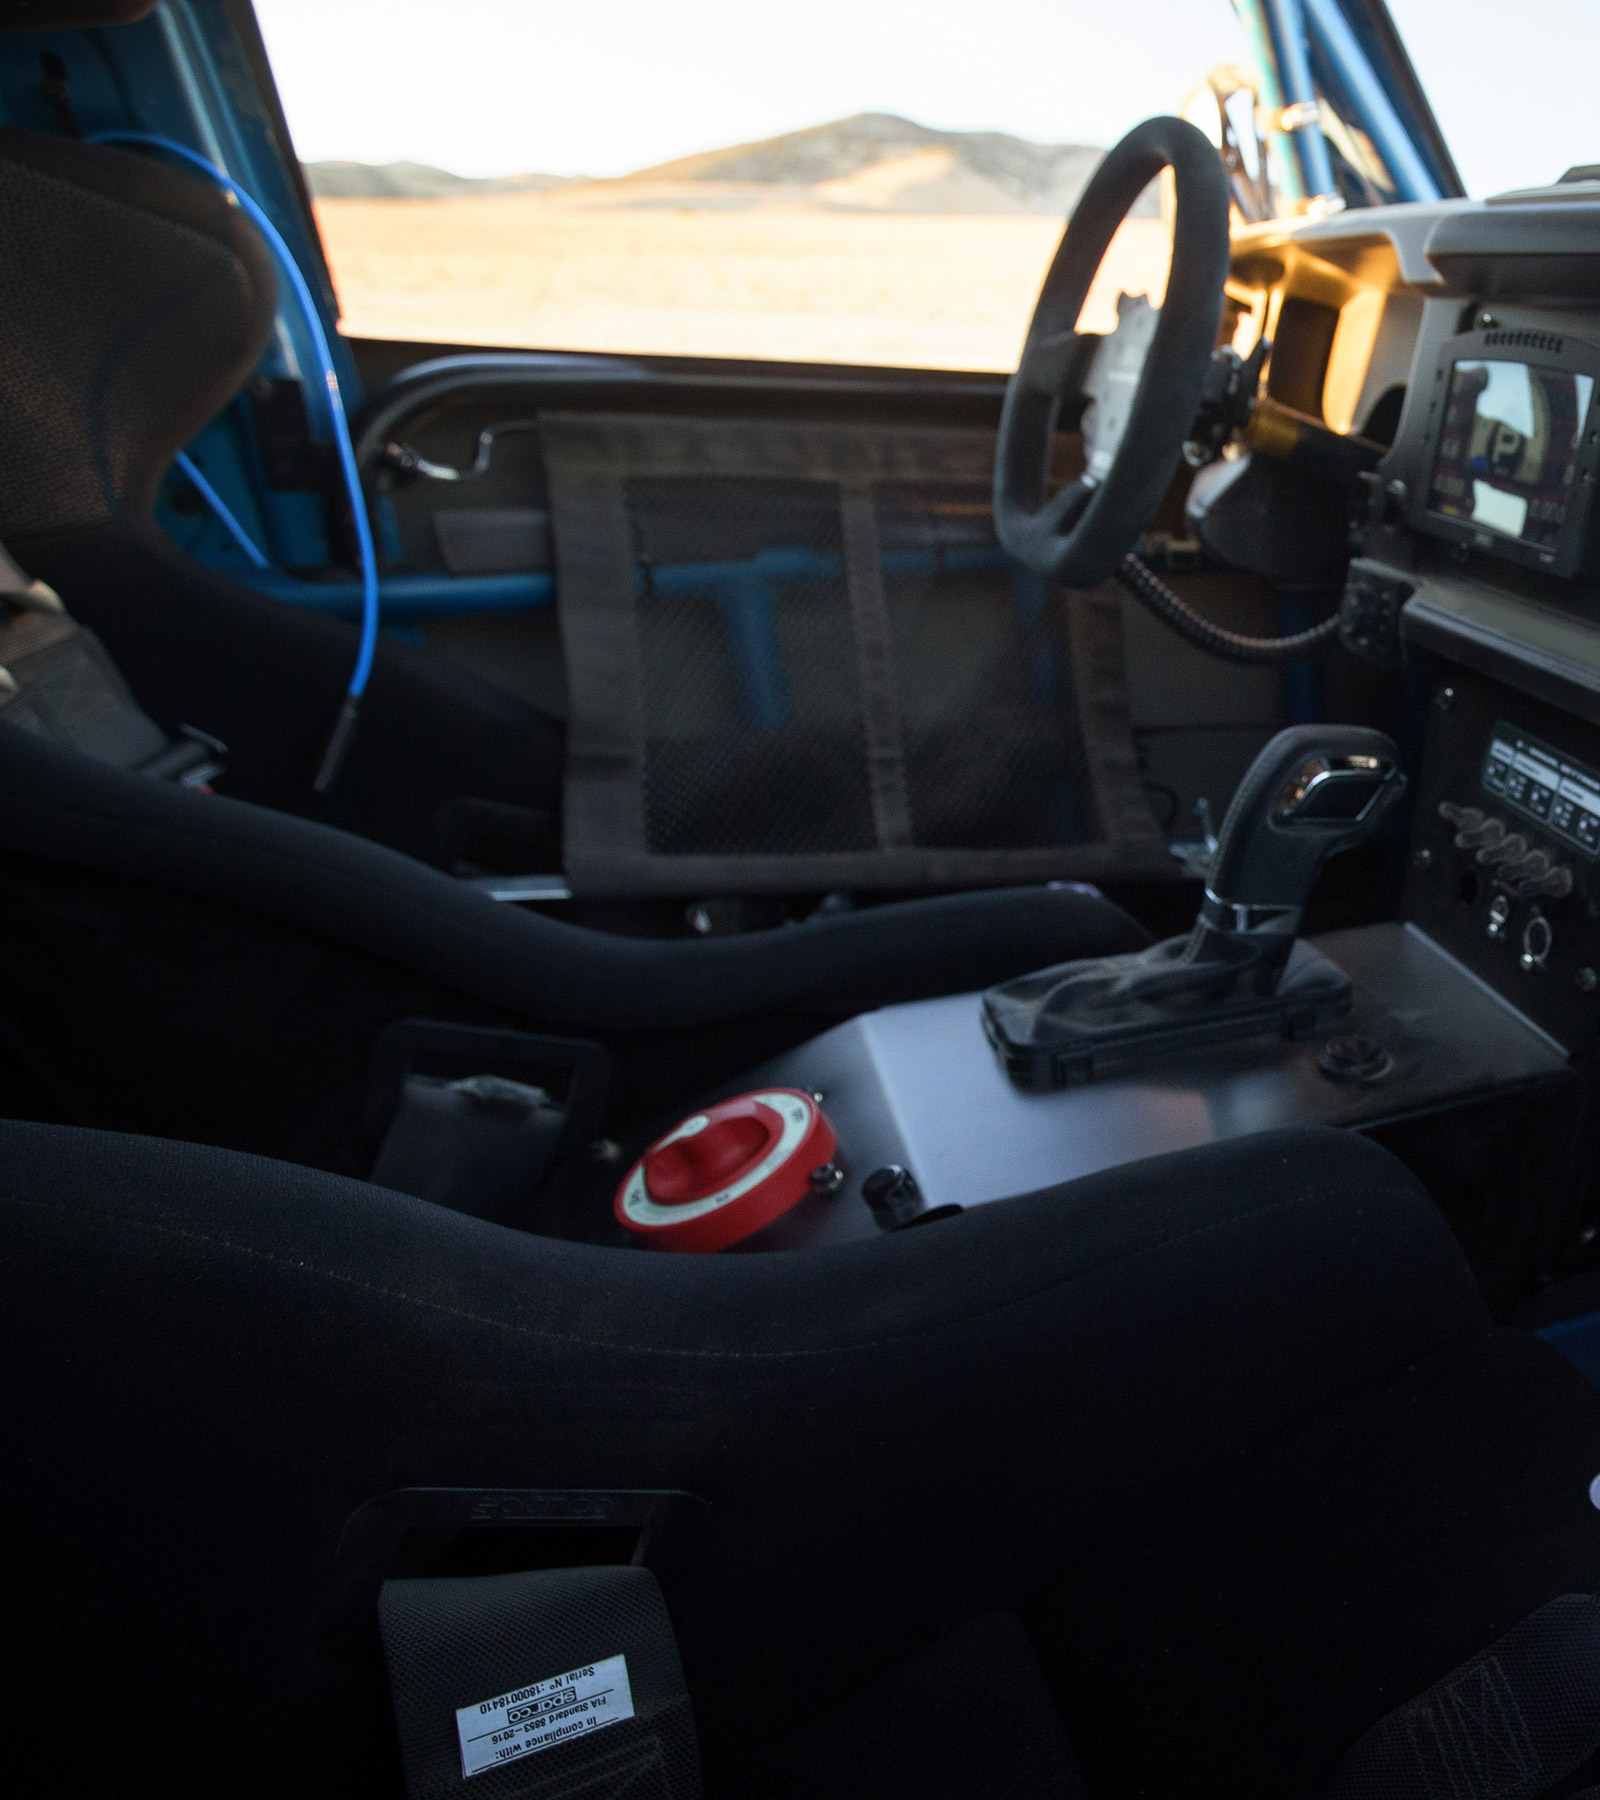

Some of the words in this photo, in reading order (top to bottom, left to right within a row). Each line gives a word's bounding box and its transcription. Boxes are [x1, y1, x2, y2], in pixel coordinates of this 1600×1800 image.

[566, 1666, 596, 1685] Serial
[507, 1686, 577, 1725] sparco
[594, 1696, 607, 1708] FIA
[549, 1702, 589, 1723] Standard
[586, 1716, 598, 1727] In
[525, 1721, 584, 1748] compliance
[495, 1742, 523, 1760] with:
